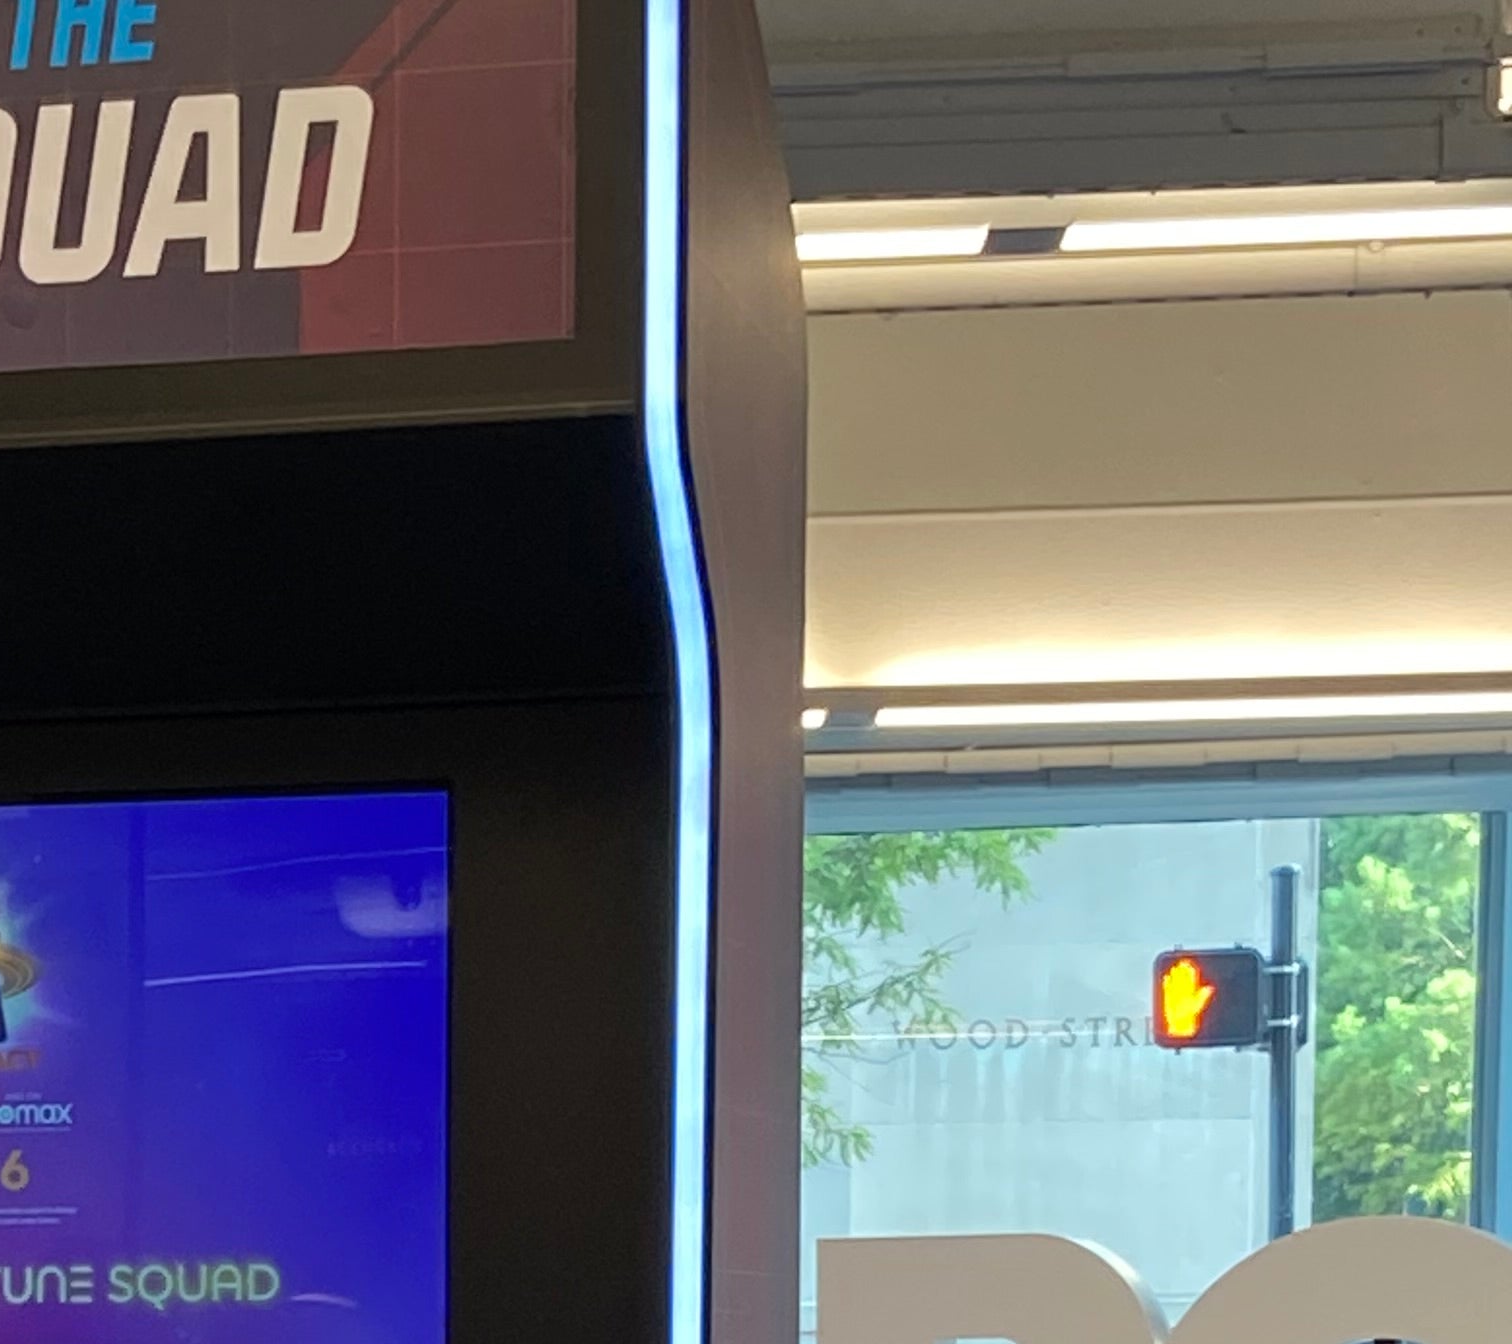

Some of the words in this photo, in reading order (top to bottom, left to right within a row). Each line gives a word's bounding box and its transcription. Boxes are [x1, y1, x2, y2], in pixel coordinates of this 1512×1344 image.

[7, 0, 158, 71] THE
[892, 1017, 1030, 1051] WOOD
[1058, 1015, 1155, 1049] STR
[106, 1262, 281, 1310] SQUAD
